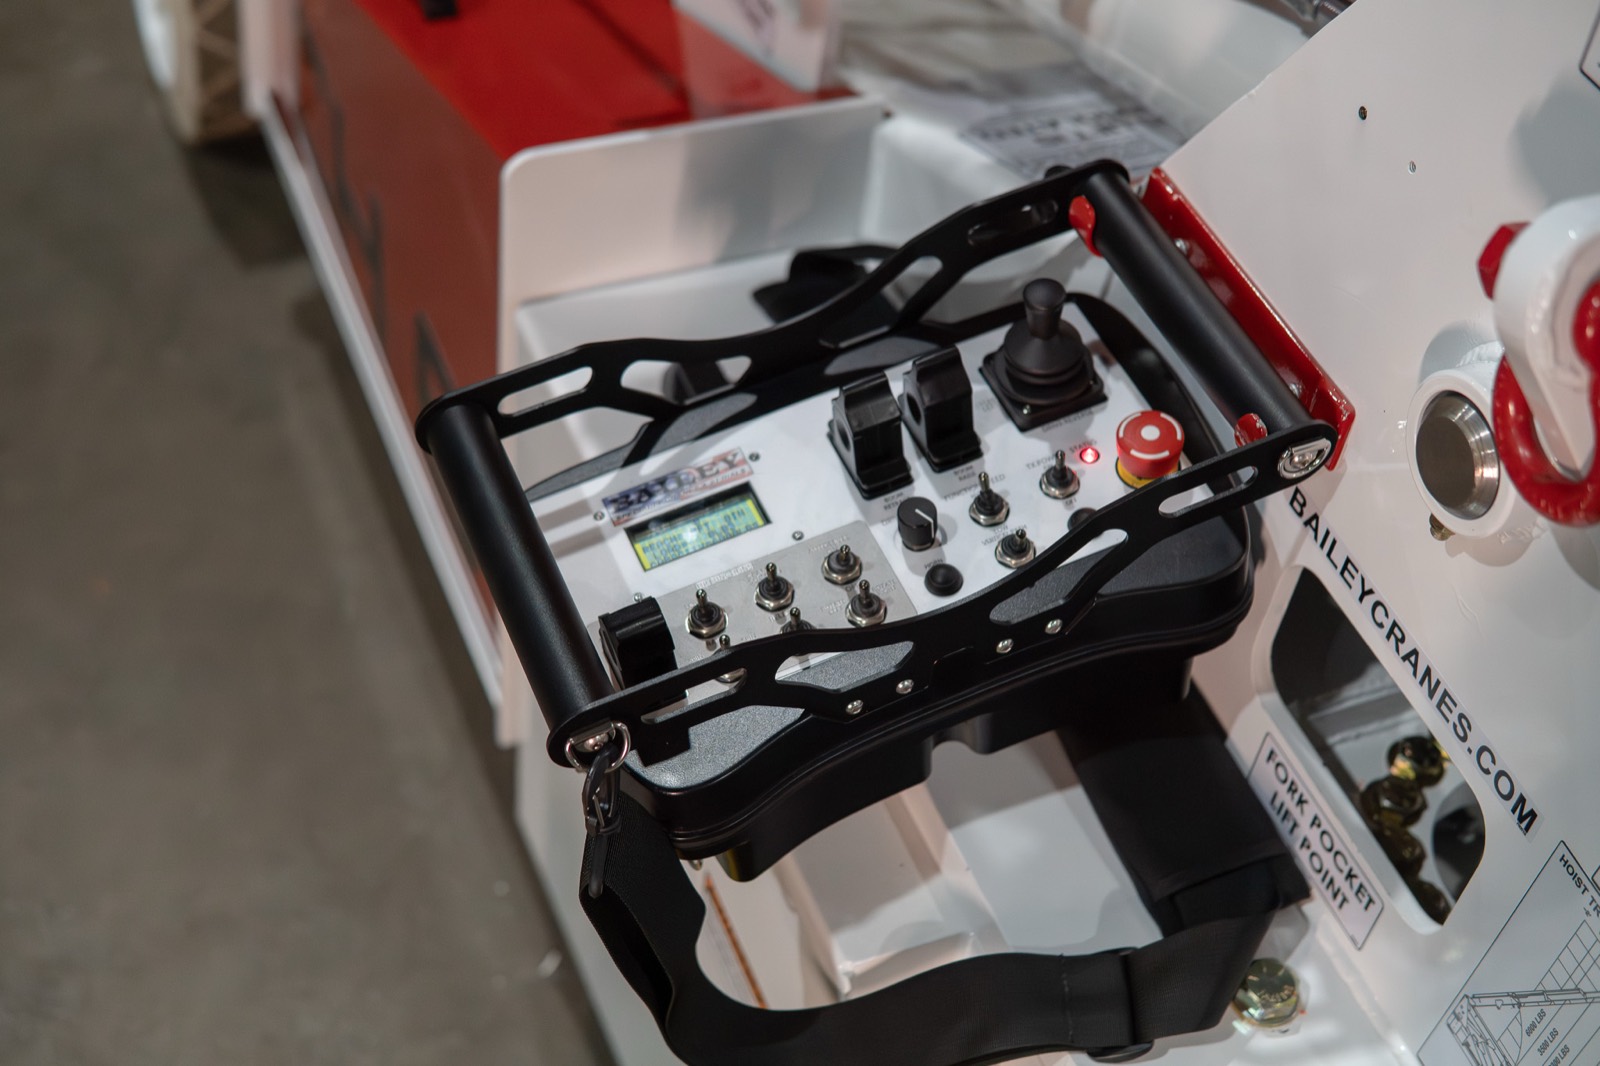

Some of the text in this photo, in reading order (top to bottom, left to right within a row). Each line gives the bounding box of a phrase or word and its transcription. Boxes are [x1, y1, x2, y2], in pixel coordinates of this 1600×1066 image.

[1288, 486, 1538, 834] BAILEYCRANES.COM
[1266, 748, 1376, 912] FORK POCKET
[1269, 790, 1350, 911] LIFT POINT
[1559, 853, 1590, 896] HOIST
[1534, 1008, 1547, 1025] LBS
[1546, 1027, 1559, 1043] LBS
[1557, 1044, 1570, 1061] LBS
